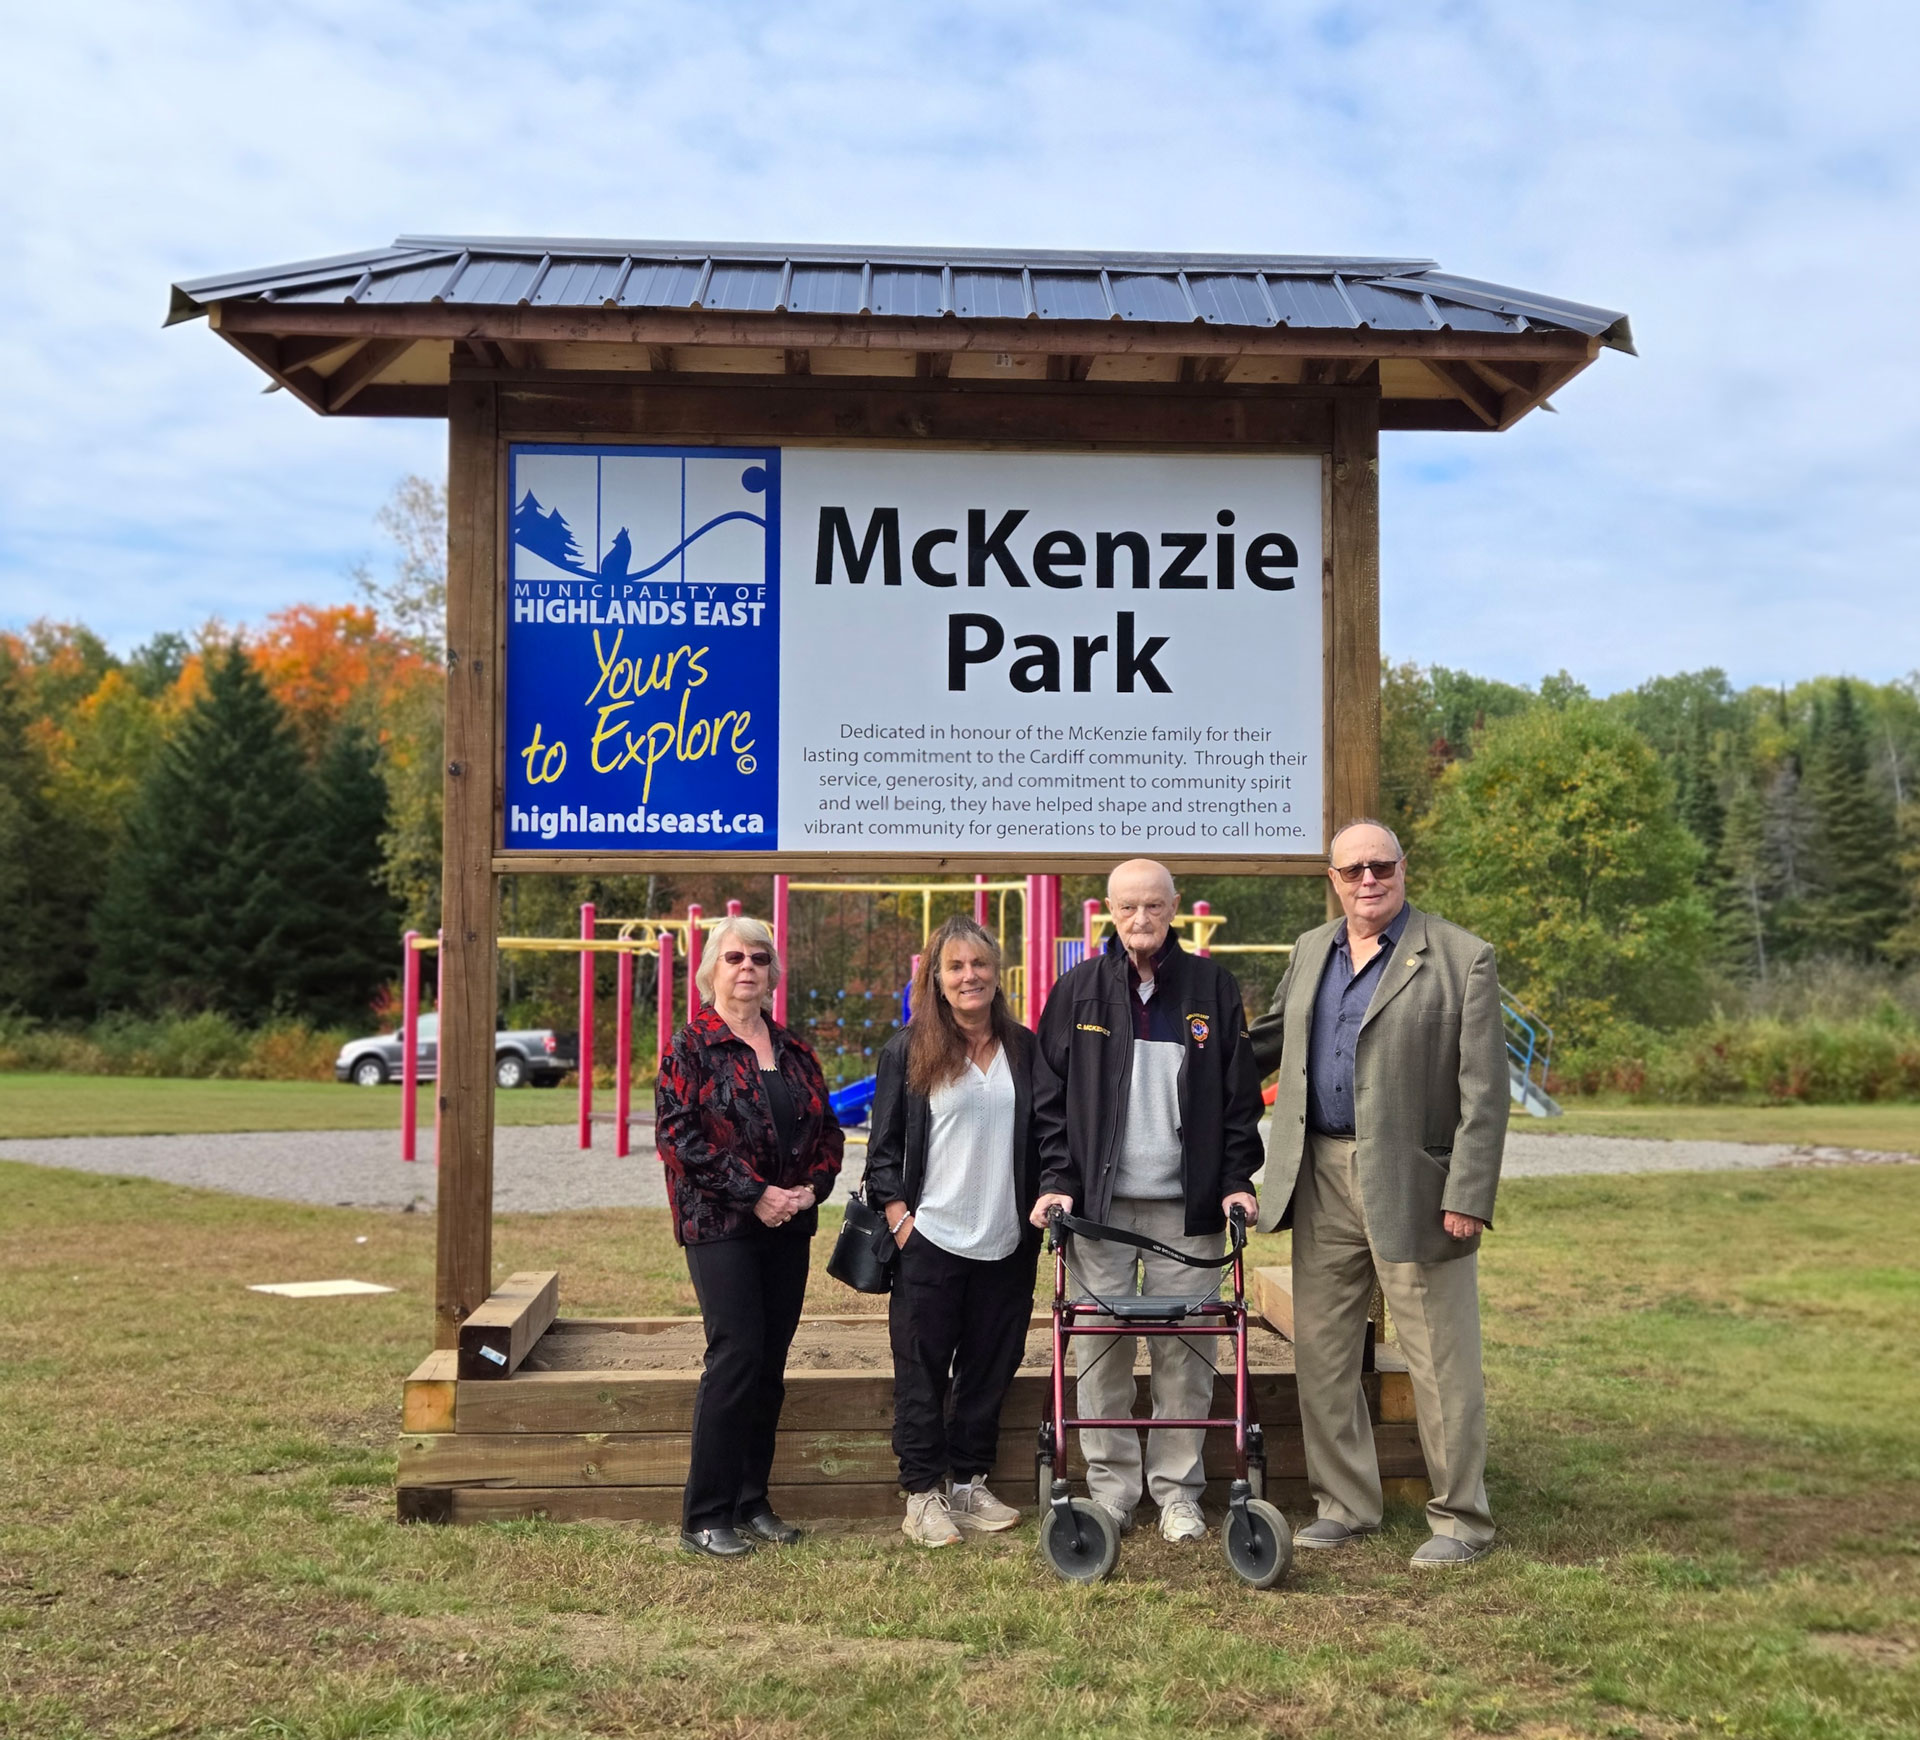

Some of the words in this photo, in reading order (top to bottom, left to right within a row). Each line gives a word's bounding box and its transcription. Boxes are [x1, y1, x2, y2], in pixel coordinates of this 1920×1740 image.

[815, 506, 1299, 592] McKenzie
[514, 583, 717, 600] MUNICIPALITY
[735, 586, 767, 601] OF
[514, 599, 687, 625] HIGHLANDS
[694, 601, 766, 627] EAST
[948, 611, 1173, 694] Park
[585, 628, 710, 707] Yours
[521, 722, 567, 785] to
[591, 688, 756, 804] Explore
[840, 723, 925, 740] Dedicated
[930, 724, 945, 740] in
[950, 723, 1012, 740] honour
[1015, 724, 1034, 740] of
[1036, 724, 1064, 741] the
[1068, 725, 1148, 741] McKenzie
[1151, 725, 1202, 746] family
[1206, 726, 1229, 742] for
[1233, 726, 1272, 742] their
[803, 746, 859, 767] lasting
[863, 748, 972, 764] commitment
[976, 749, 994, 764] to
[998, 748, 1026, 764] the
[1029, 748, 1086, 765] Cardiff
[1088, 750, 1187, 769] community.
[1193, 749, 1265, 770] Through
[1269, 750, 1308, 766] their
[819, 771, 881, 789] service,
[885, 772, 978, 792] generosity,
[981, 772, 1013, 788] and
[1017, 773, 1126, 789] commitment
[1129, 775, 1147, 789] to
[1151, 774, 1247, 793] community
[1250, 774, 1292, 793] spirit
[818, 794, 851, 811] and
[855, 795, 889, 811] well
[894, 795, 946, 815] being,
[950, 795, 988, 816] they
[992, 795, 1032, 812] have
[1036, 796, 1093, 816] helped
[1097, 796, 1147, 816] shape
[1151, 797, 1183, 813] and
[1187, 797, 1278, 817] strengthen
[1282, 802, 1291, 814] a
[511, 804, 765, 840] highlandseast.ca
[803, 818, 864, 835] vibrant
[868, 820, 965, 840] community
[968, 819, 993, 835] for
[996, 820, 1095, 840] generations
[1099, 822, 1117, 836] to
[1121, 820, 1142, 836] be
[1146, 821, 1196, 840] proud
[1200, 823, 1218, 837] to
[1222, 821, 1249, 837] call
[1254, 821, 1306, 837] home.
